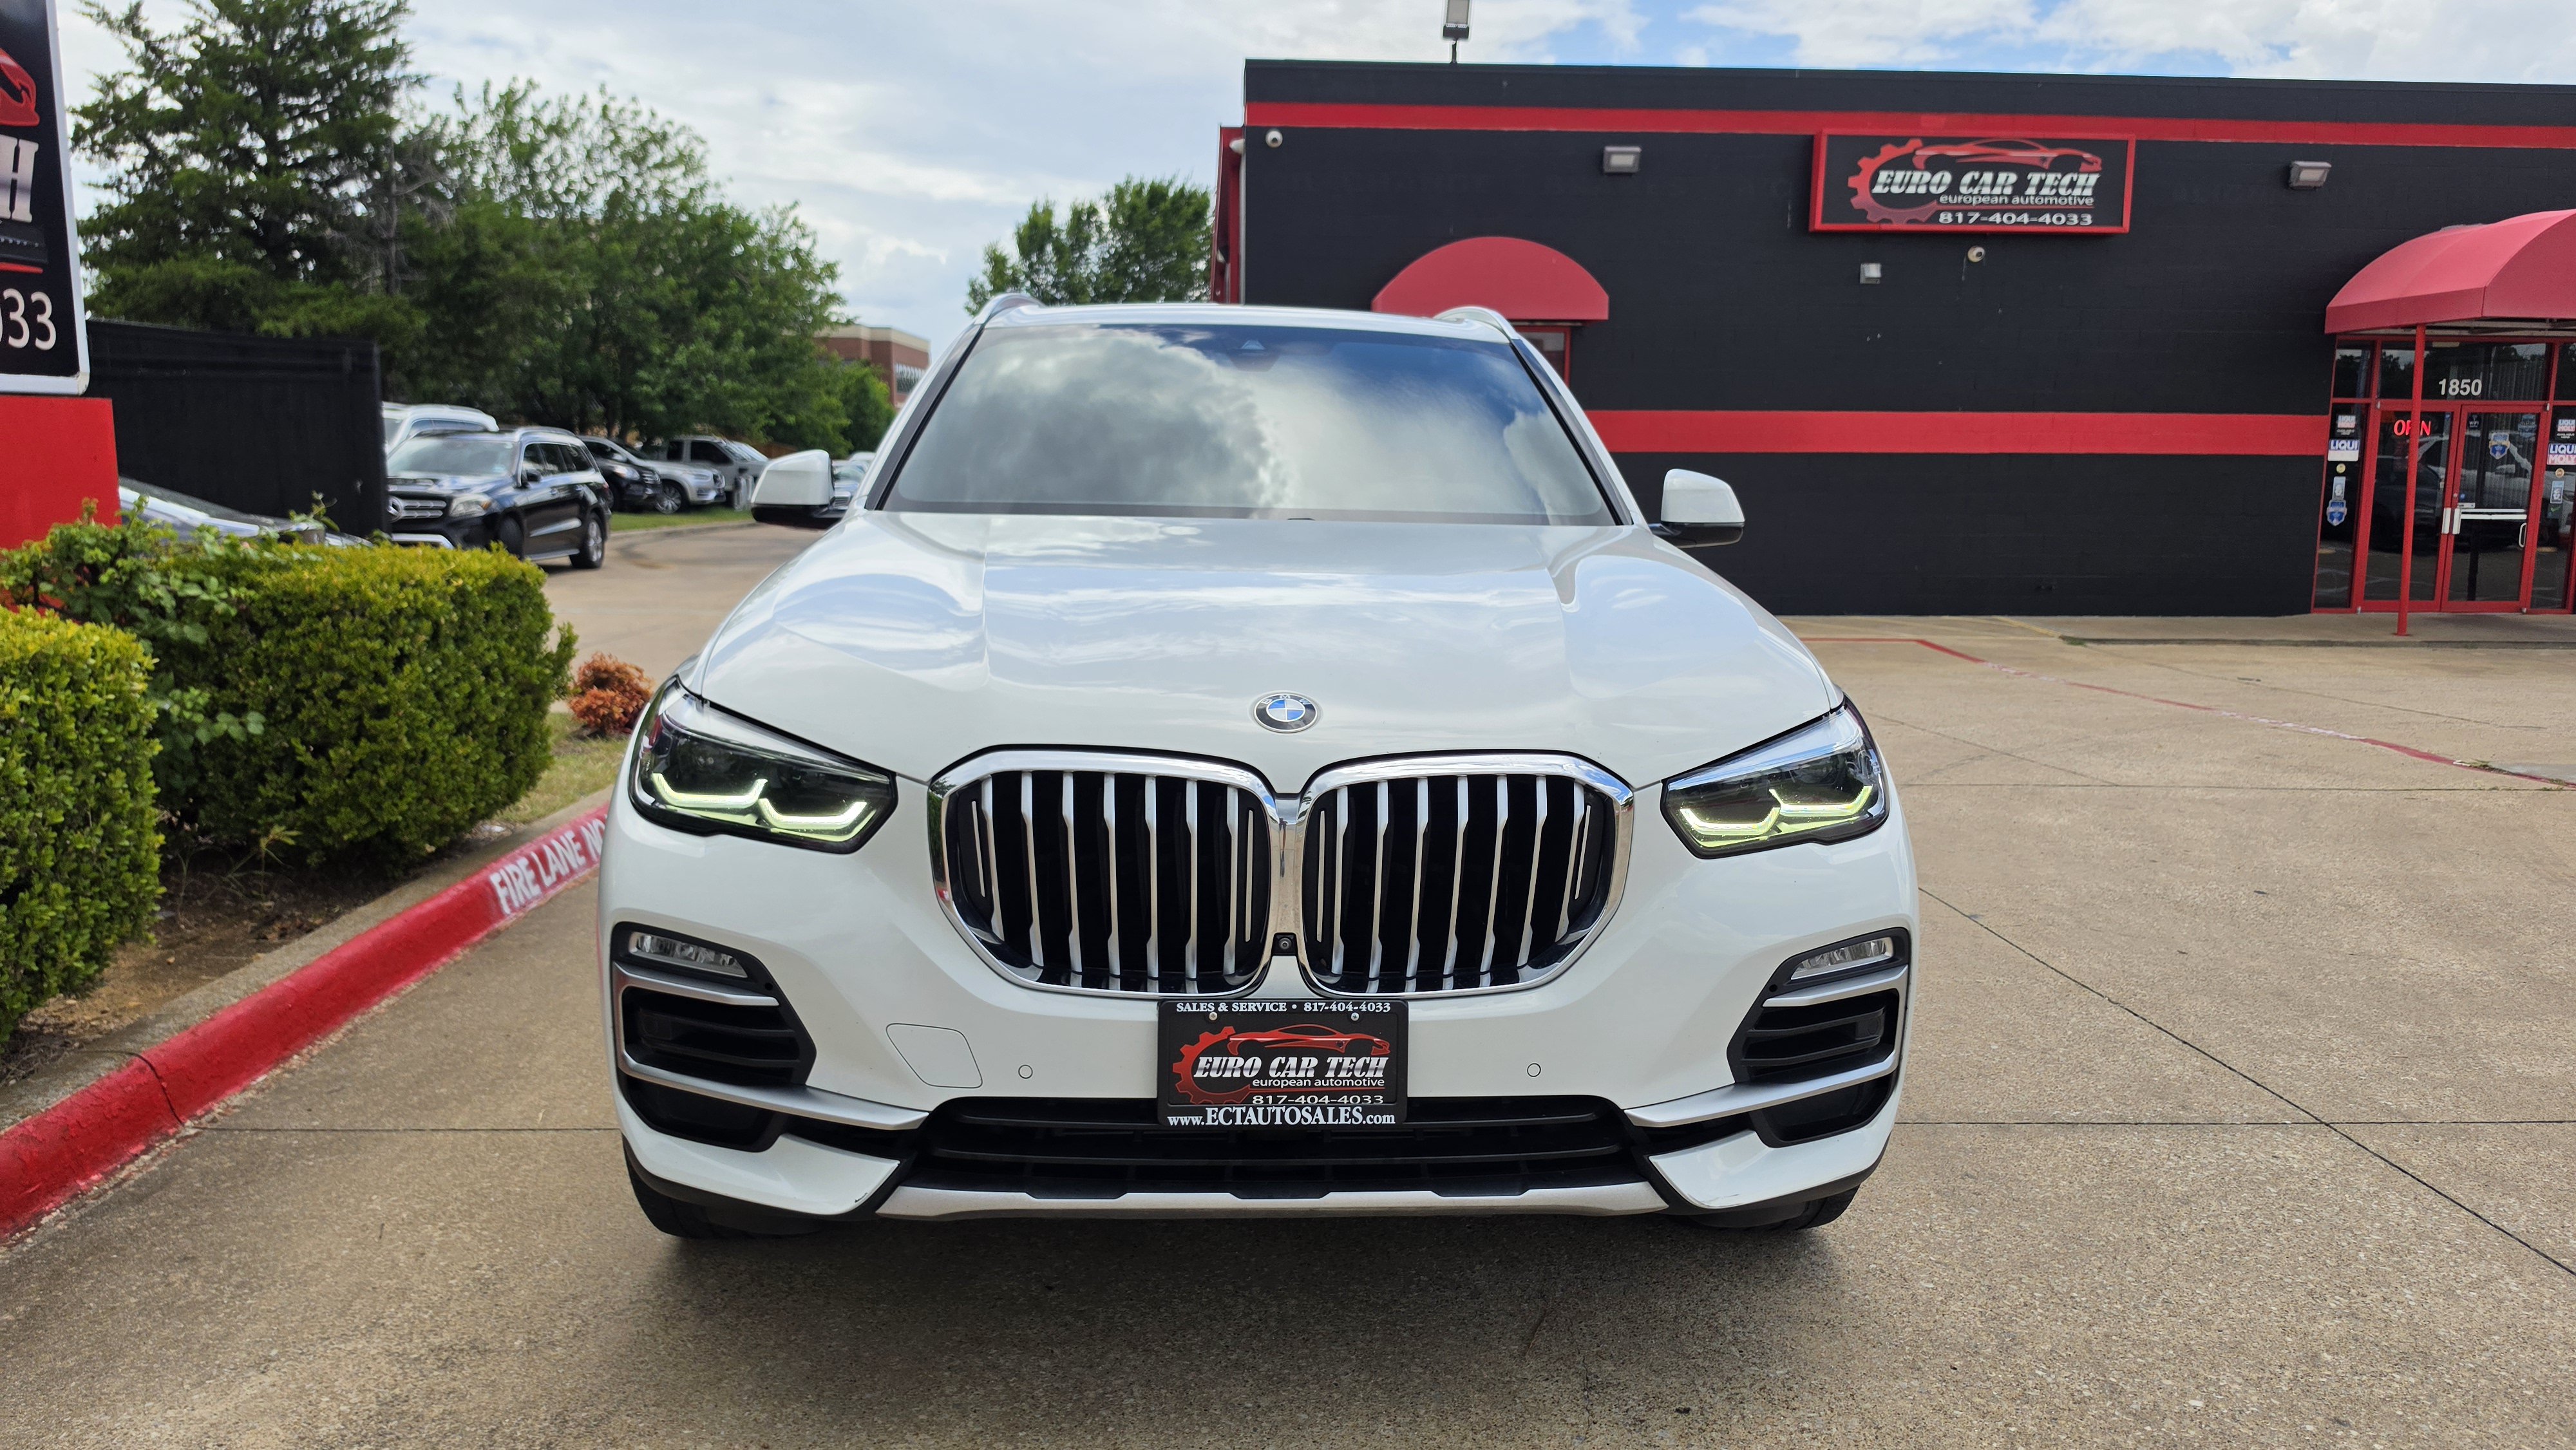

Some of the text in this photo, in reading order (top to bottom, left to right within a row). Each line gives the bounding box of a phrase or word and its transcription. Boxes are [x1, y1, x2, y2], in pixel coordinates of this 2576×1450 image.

[1871, 170, 2101, 196] EURO CAR TECH
[1940, 194, 2094, 206] european automotive
[1938, 211, 2092, 225] 817-404-4033
[2438, 378, 2482, 396] 1850
[2330, 440, 2358, 450] LIQUI
[1260, 695, 1311, 705] BMW
[489, 856, 542, 915] FIRE
[530, 830, 586, 887] LANE
[1176, 1001, 1391, 1012] SALES & SERVICE 817-404-4033
[1193, 1056, 1389, 1078] EURO CAR TECH
[1252, 1077, 1385, 1089] european automotive
[1252, 1095, 1384, 1104] 817-404-4033
[1167, 1106, 1396, 1125] www.ECTAUTOSALES.com
